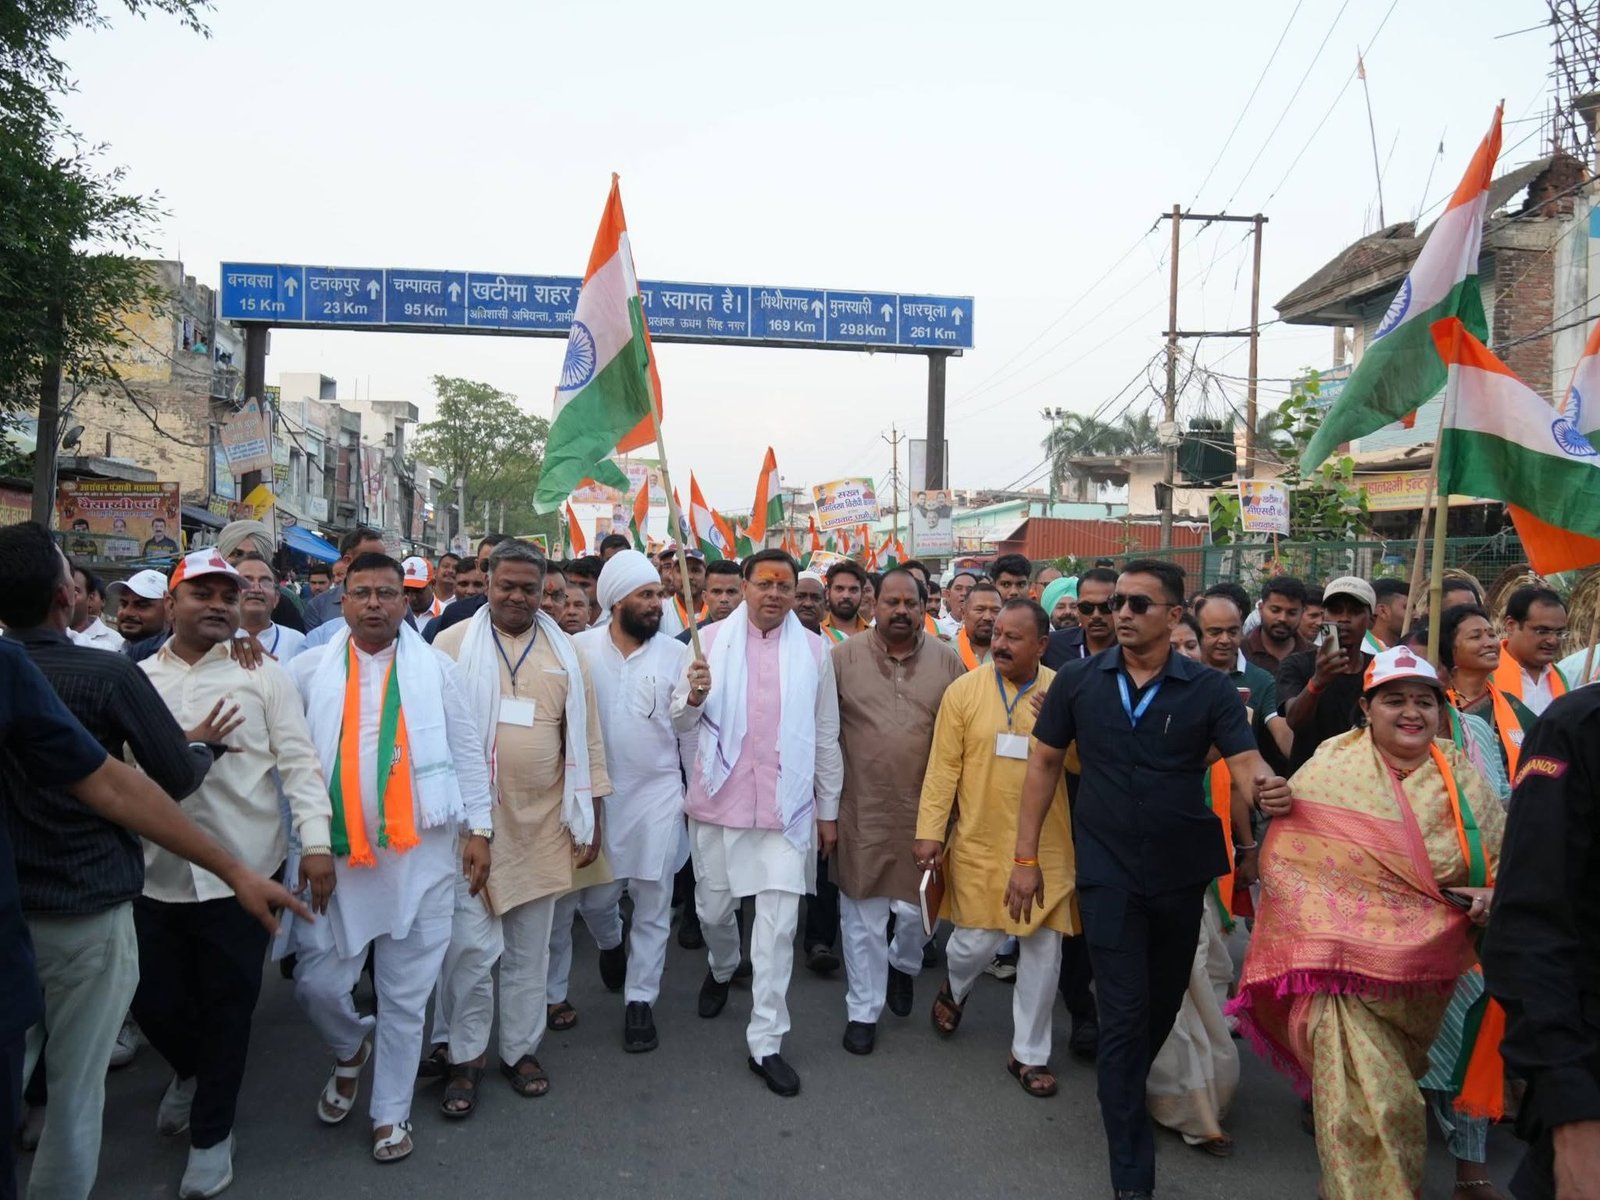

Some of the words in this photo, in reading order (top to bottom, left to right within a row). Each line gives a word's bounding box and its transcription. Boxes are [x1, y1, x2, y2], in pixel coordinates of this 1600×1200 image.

[227, 273, 273, 289] बनबसा
[310, 277, 360, 297] टनकपुर
[393, 278, 442, 294] चम्पावत
[471, 276, 528, 302] खटीमा
[533, 285, 572, 305] शहर
[240, 298, 256, 311] 15
[260, 299, 286, 312] Km
[323, 301, 341, 314] 23
[343, 302, 368, 315] Km
[661, 291, 714, 311] स्वागत
[760, 289, 808, 313] पिथौरागढ़
[830, 296, 872, 318] मुनस्यारी
[404, 303, 421, 316] 95
[424, 304, 448, 317] Km
[554, 309, 576, 323] ग्रामी
[902, 303, 947, 322] धारचूला
[680, 318, 702, 329] ऊधम
[707, 316, 723, 331] सिंह
[727, 320, 746, 331] नगर
[768, 319, 790, 331] 169
[794, 321, 816, 333] Km
[911, 326, 931, 338] 261
[935, 328, 956, 340] Km
